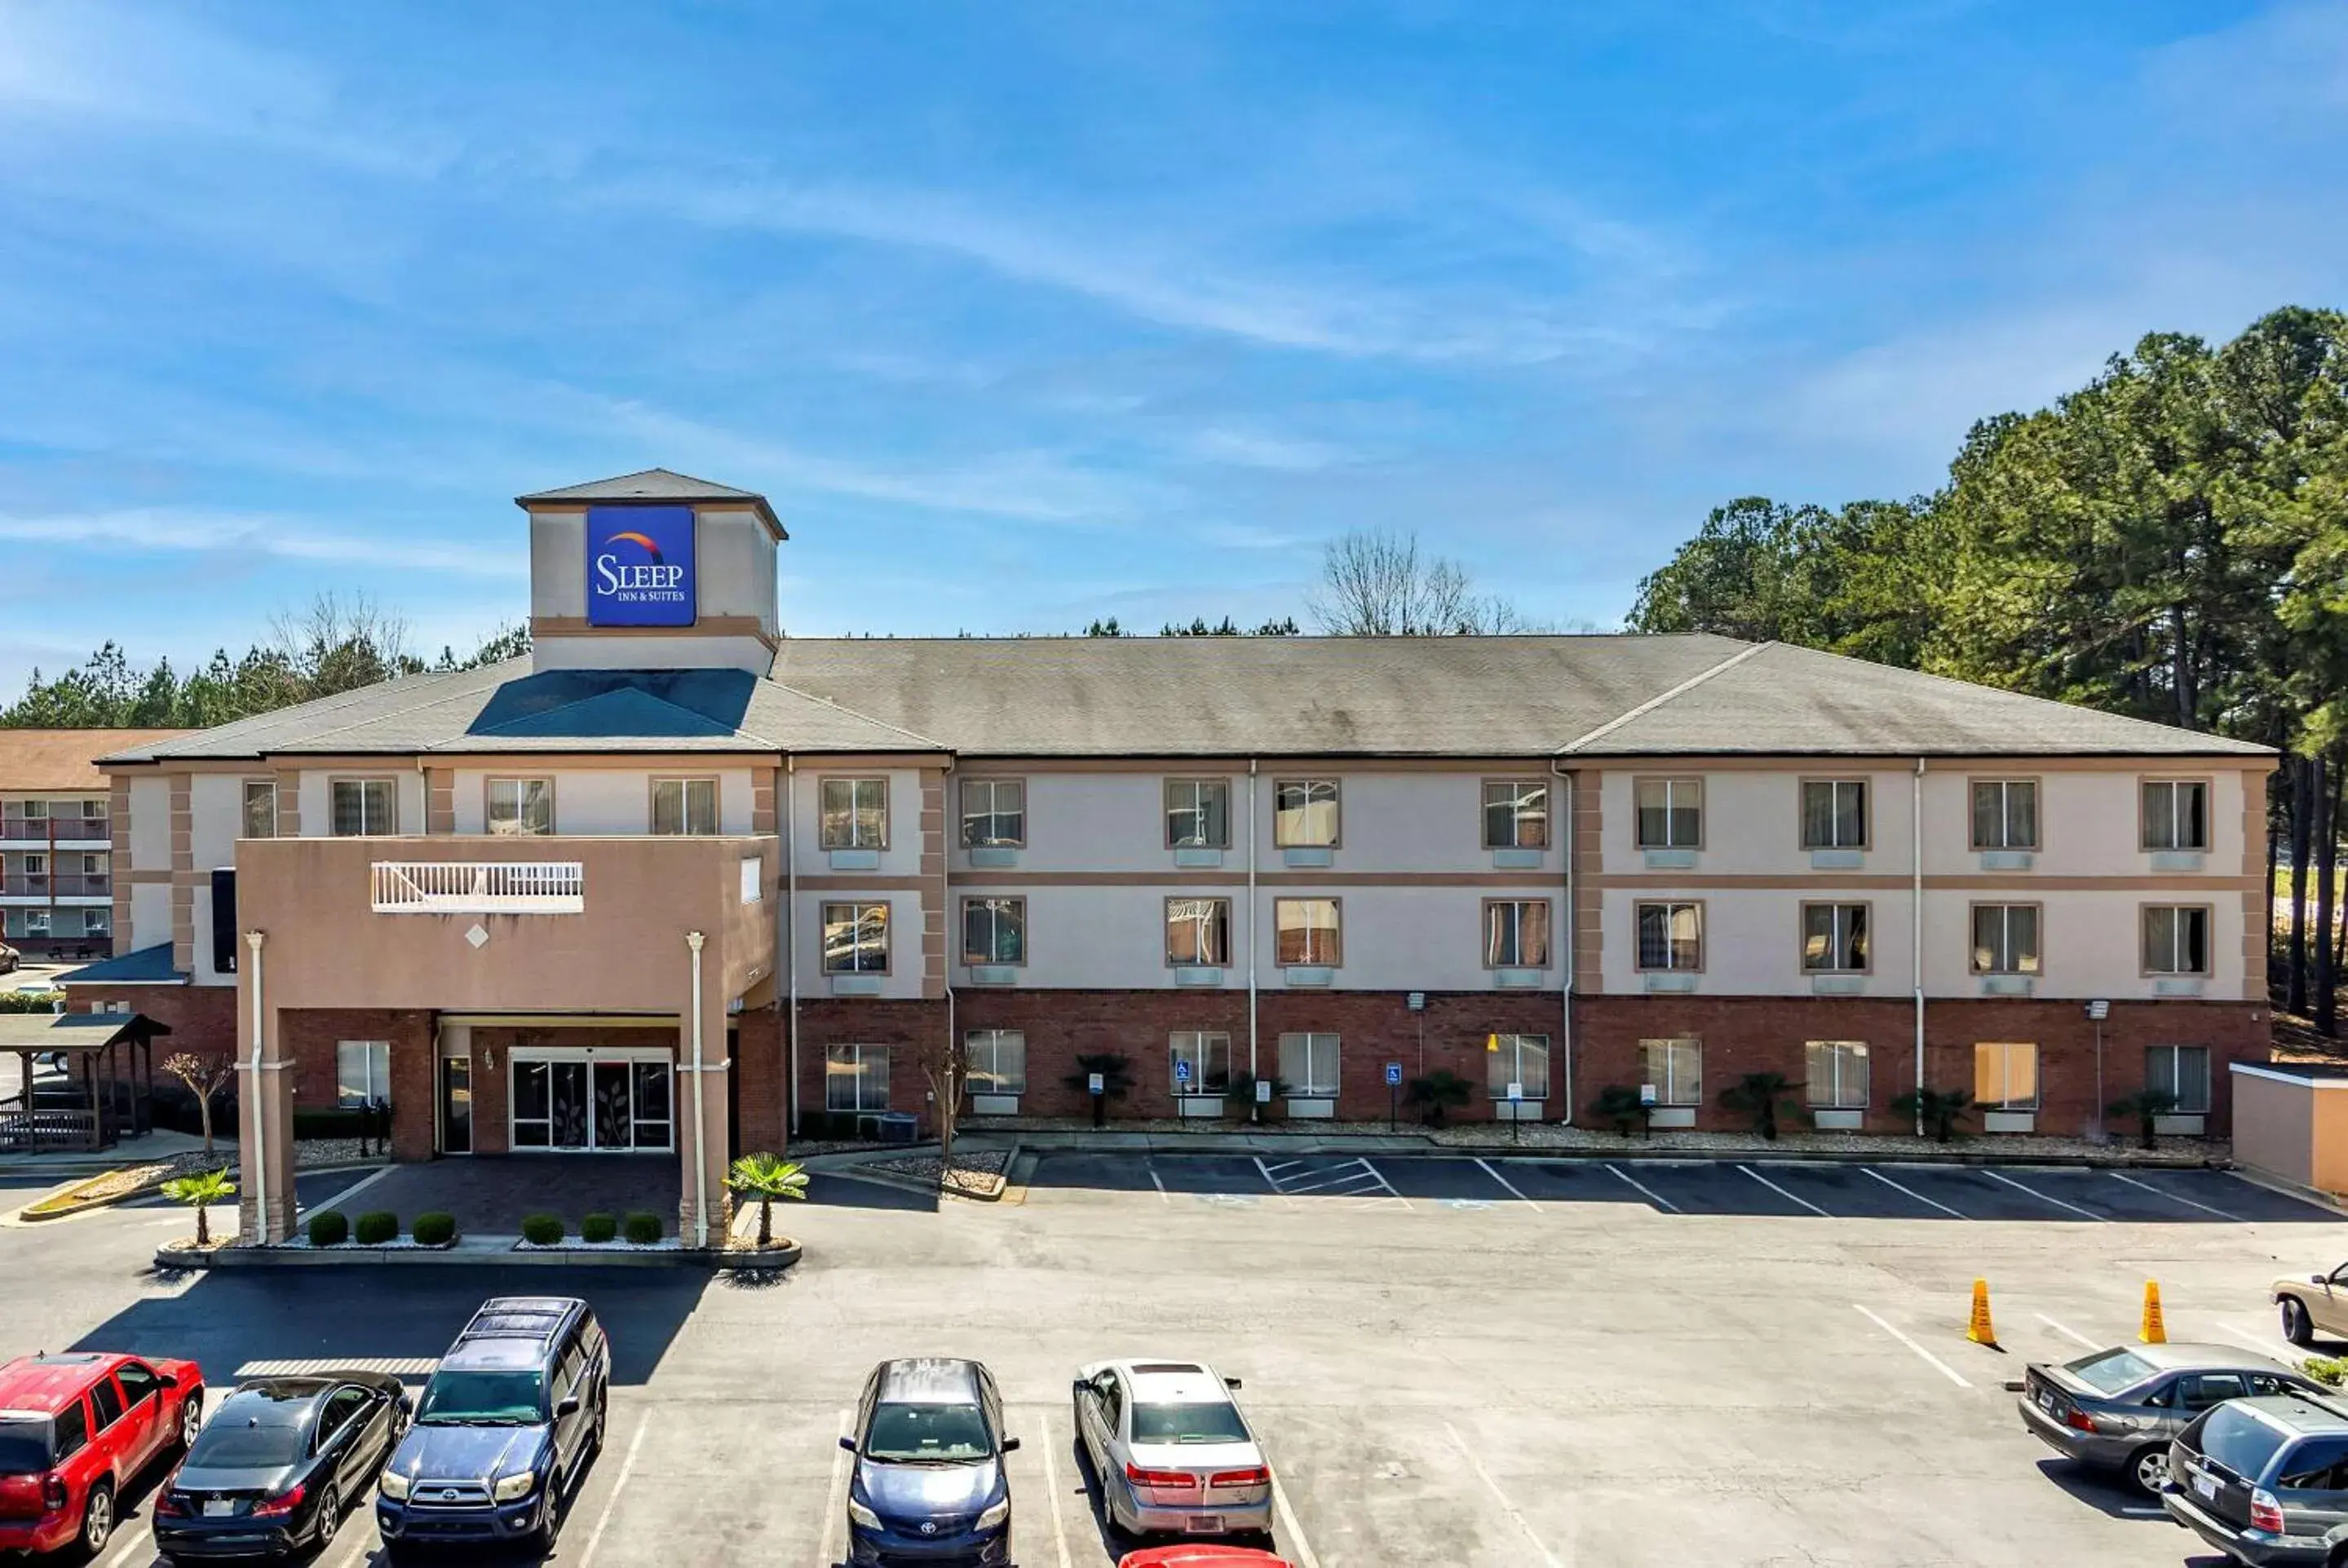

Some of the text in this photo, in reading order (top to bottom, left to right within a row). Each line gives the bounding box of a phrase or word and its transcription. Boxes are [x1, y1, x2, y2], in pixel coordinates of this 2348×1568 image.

[597, 554, 683, 595] SLEEP
[618, 590, 685, 602] INN & SUITES
